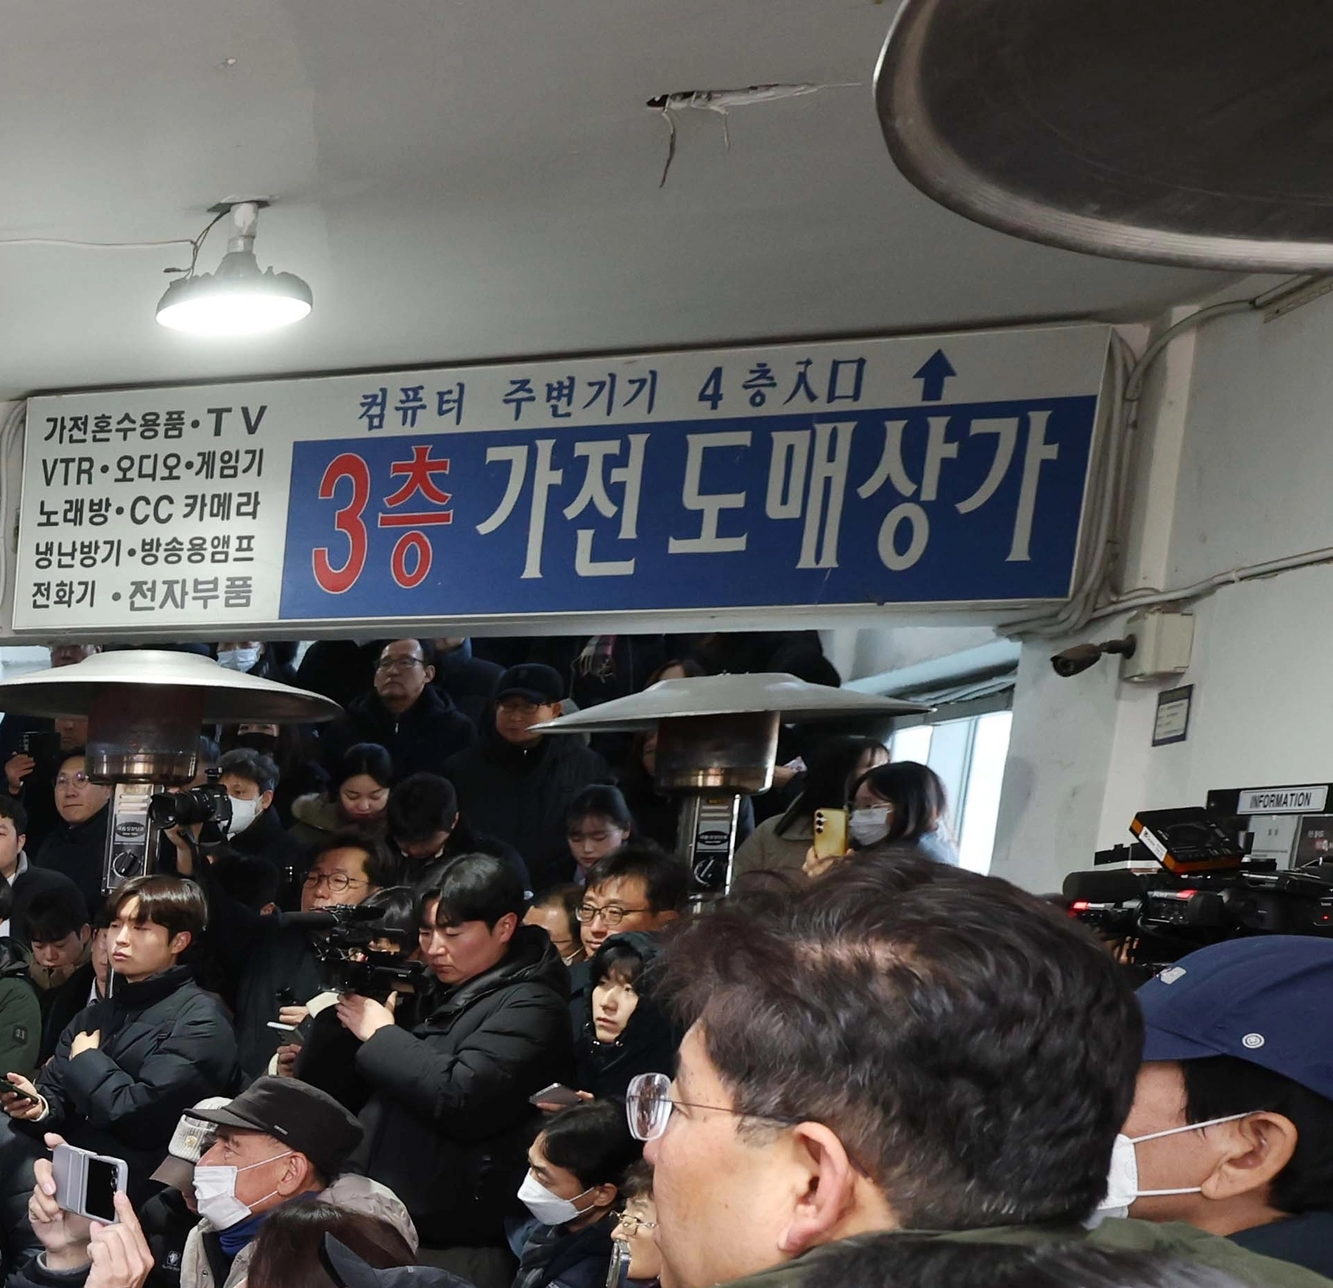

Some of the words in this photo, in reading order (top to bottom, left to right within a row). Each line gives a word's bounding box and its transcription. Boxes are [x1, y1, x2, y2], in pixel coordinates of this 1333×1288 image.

[359, 382, 466, 430] 컴퓨터
[312, 445, 454, 594] 3층
[1250, 793, 1311, 808] INFORMATION
